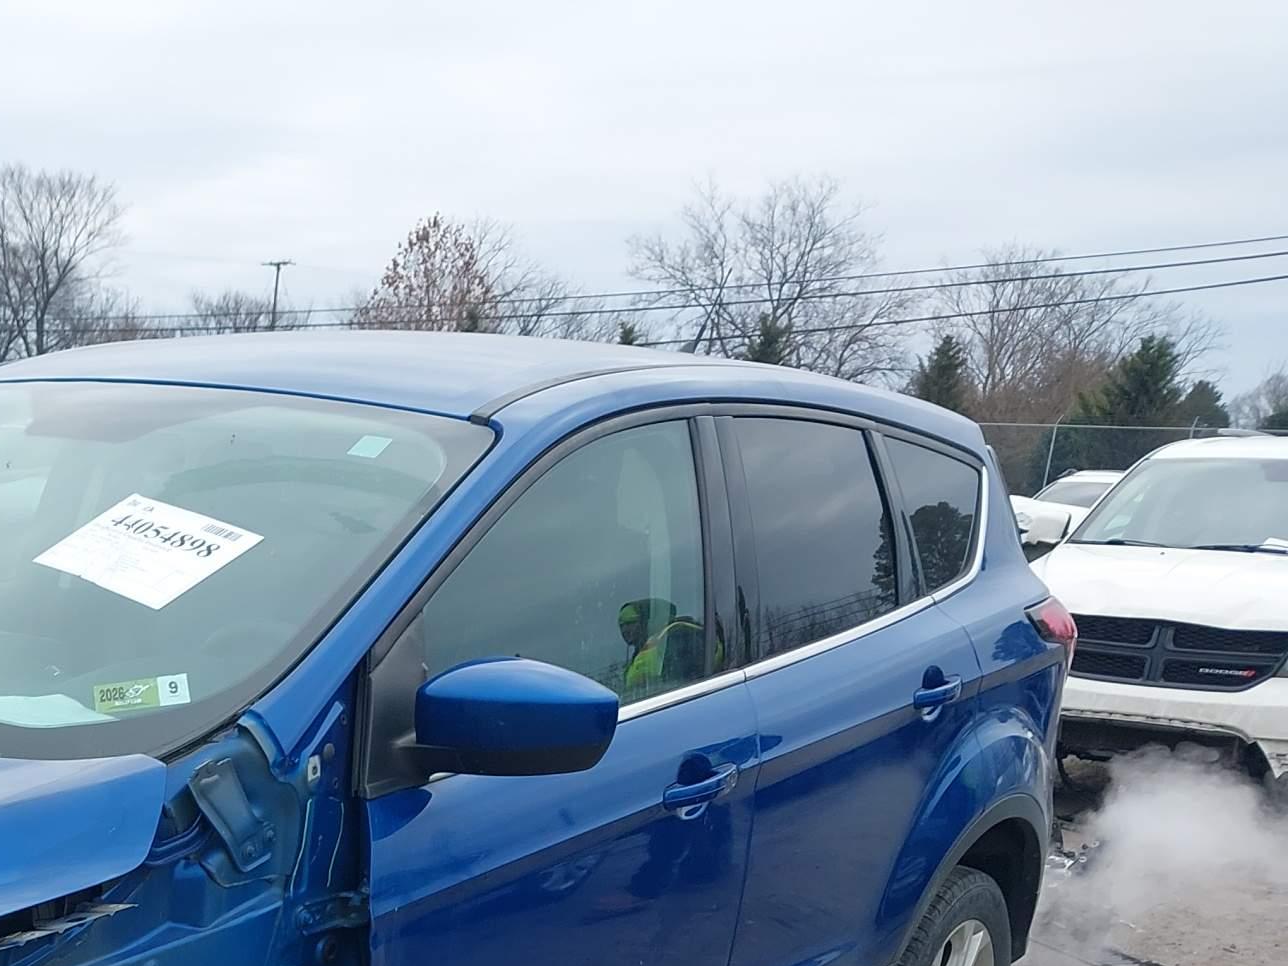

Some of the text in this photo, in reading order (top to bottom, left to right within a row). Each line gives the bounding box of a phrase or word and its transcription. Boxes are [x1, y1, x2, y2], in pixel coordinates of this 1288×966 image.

[112, 514, 221, 558] 44054898
[1199, 667, 1246, 676] DODGE
[99, 686, 126, 703] 2026
[167, 680, 179, 695] 9
